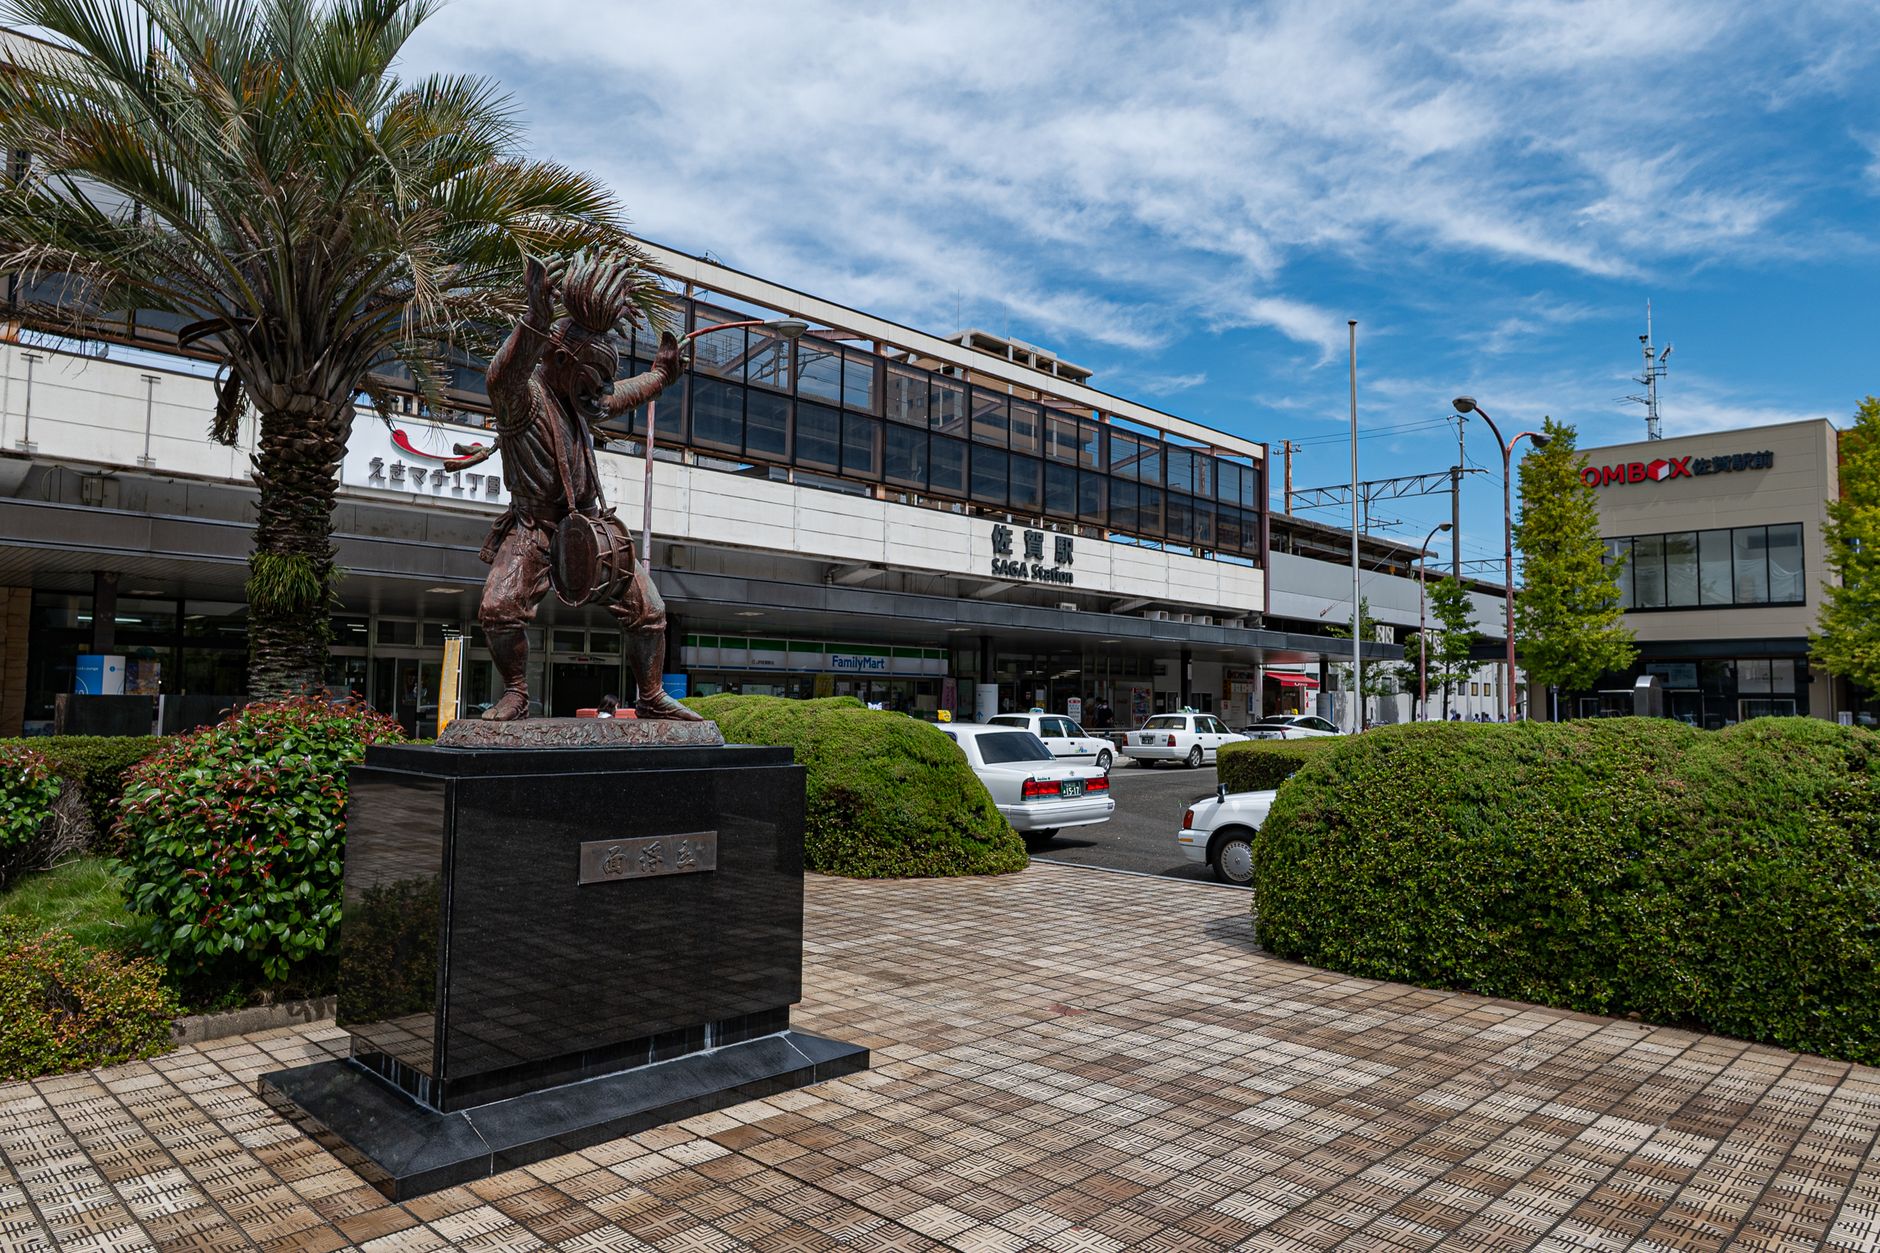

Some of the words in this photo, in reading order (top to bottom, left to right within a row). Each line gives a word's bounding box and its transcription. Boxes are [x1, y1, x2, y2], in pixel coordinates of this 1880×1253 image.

[368, 456, 501, 495] えきマチ1丁目
[1692, 450, 1774, 477] 佐賀駅前
[991, 523, 1074, 566] 佐賀駅
[991, 557, 1029, 578] SAGA
[1031, 563, 1074, 584] Station
[832, 655, 885, 671] FamilyMart
